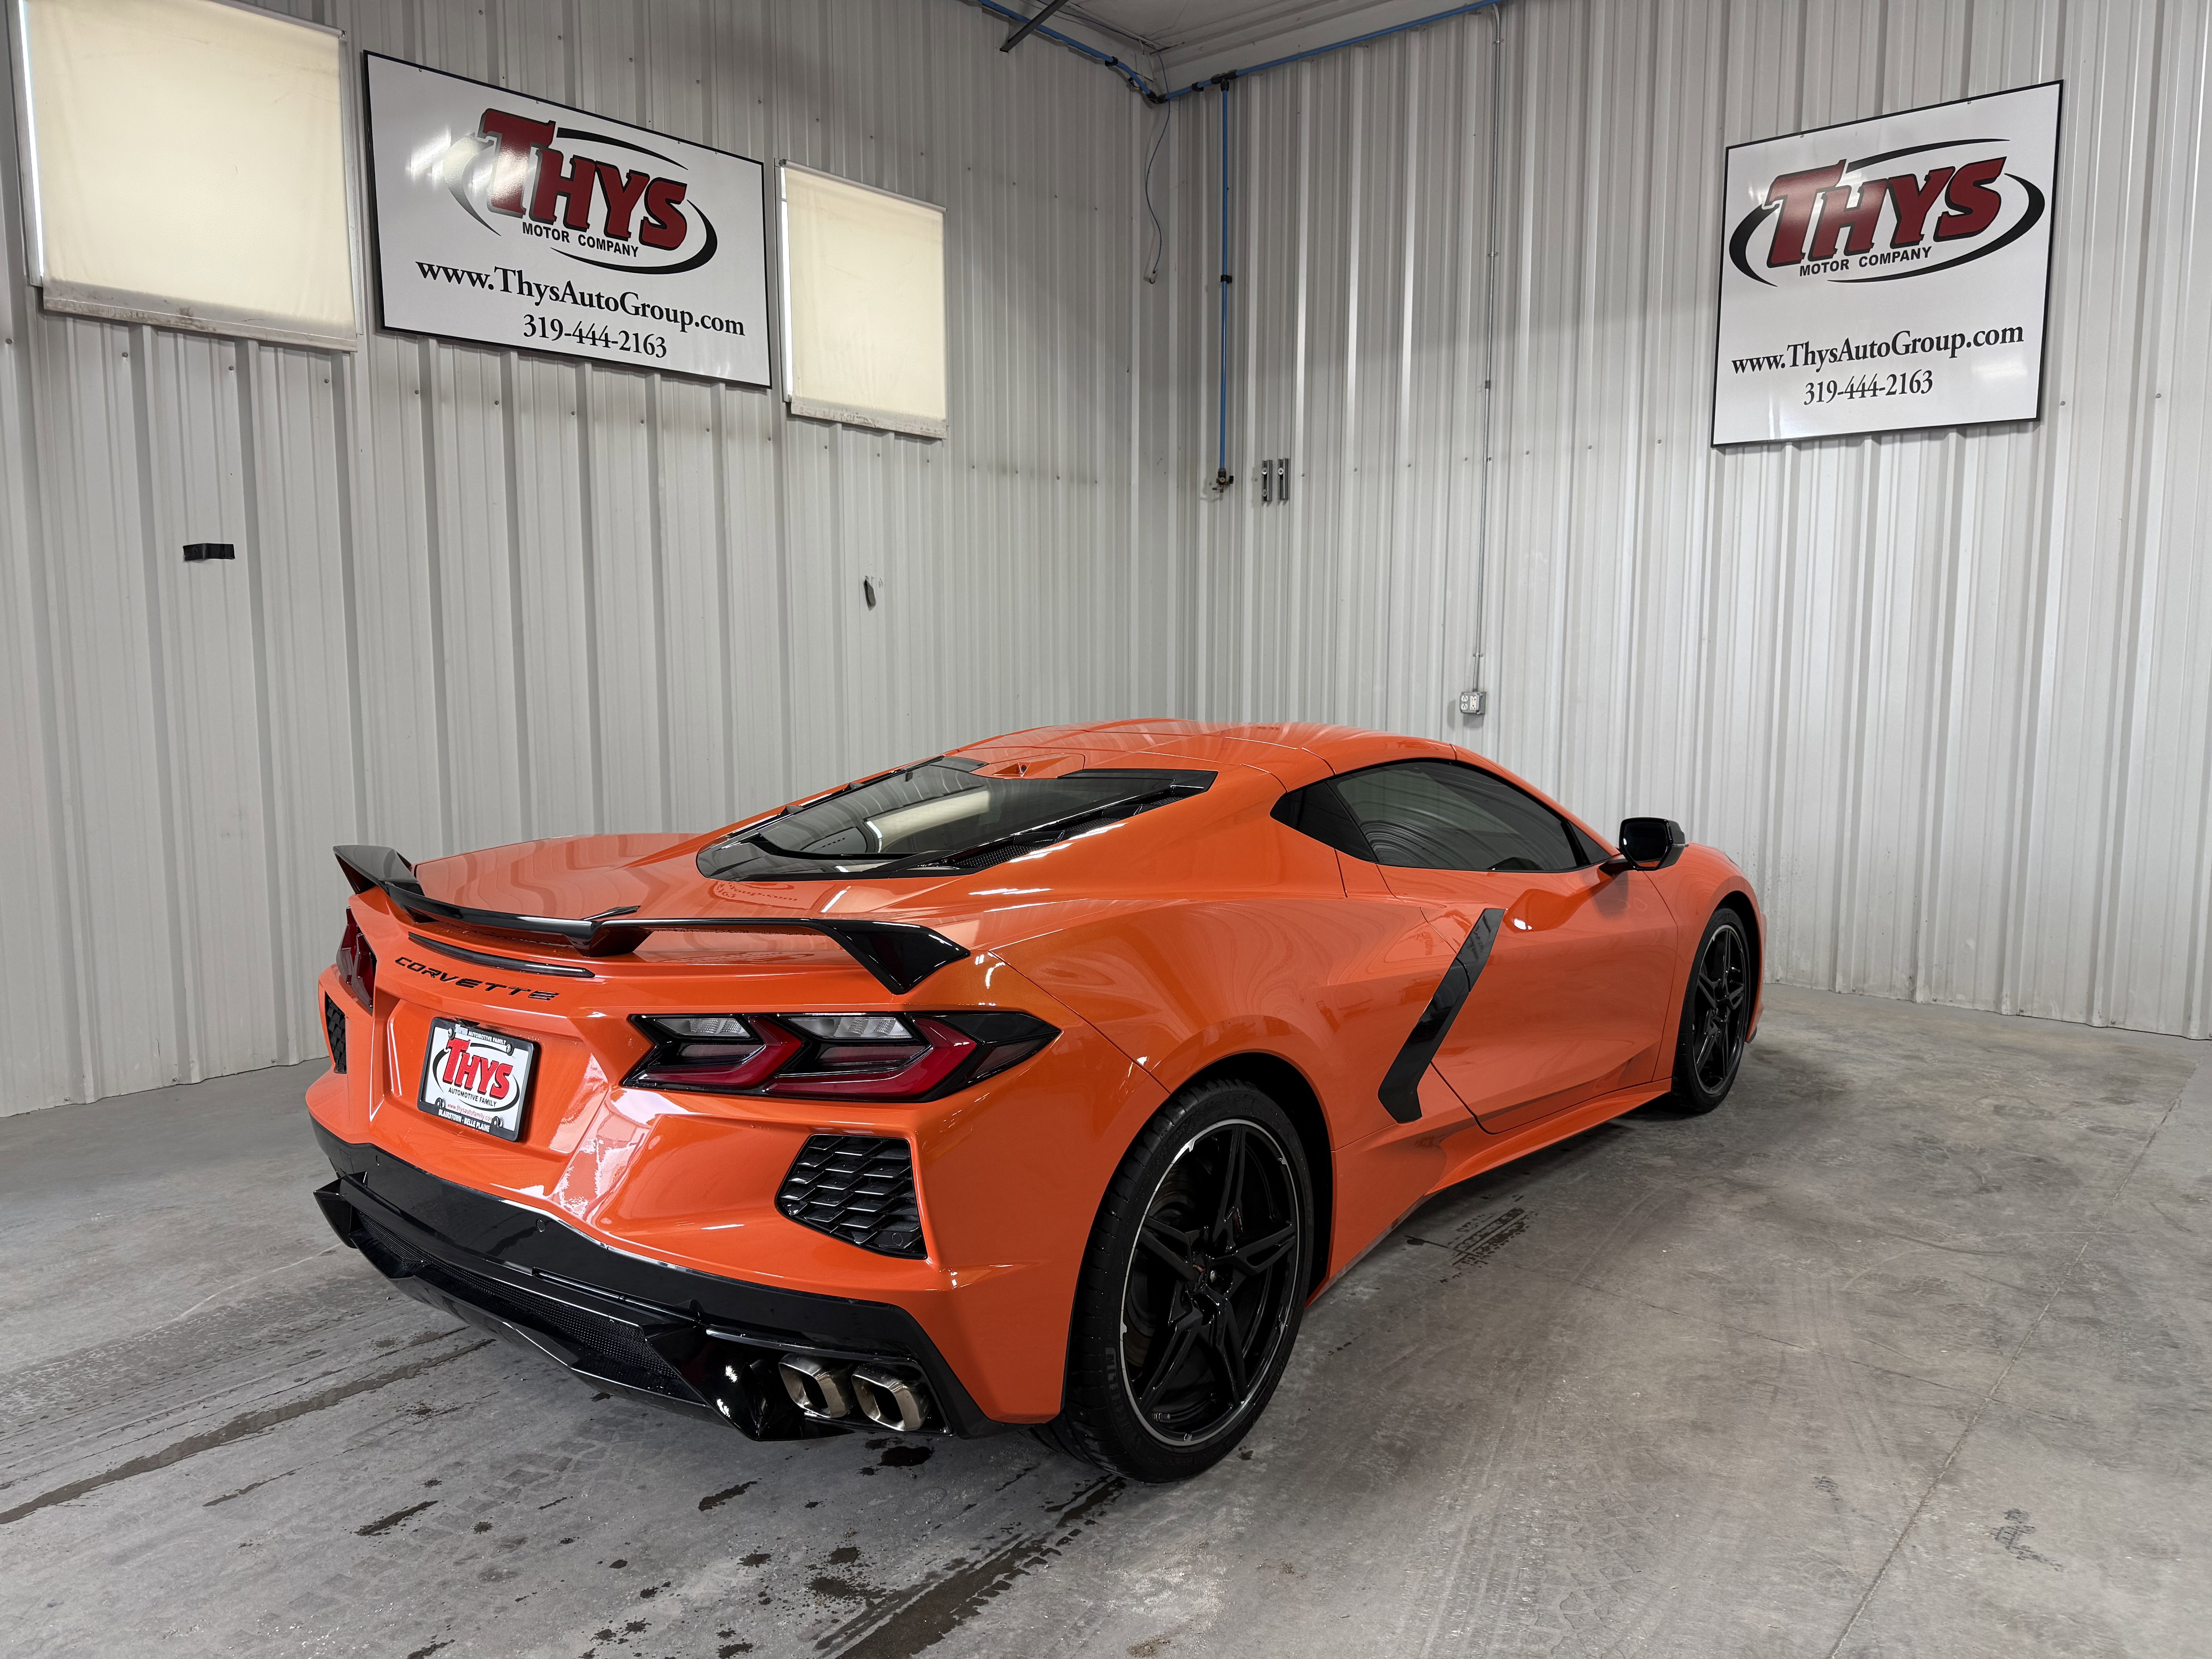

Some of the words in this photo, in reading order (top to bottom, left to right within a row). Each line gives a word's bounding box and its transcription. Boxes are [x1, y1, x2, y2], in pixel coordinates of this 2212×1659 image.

[477, 108, 689, 251] THYS
[1765, 156, 2007, 268] THYS
[523, 222, 570, 243] MOTOR
[579, 234, 639, 257] COMPANY
[1800, 259, 1849, 276] MOTOR
[1859, 246, 1932, 267] COMPANY
[416, 262, 745, 336] www.ThysAutoGroup.com
[524, 314, 667, 358] 319-444-2163
[1732, 326, 2024, 374] www.ThysAutoGroup.com
[1804, 369, 1933, 405] 319-444-2163
[395, 956, 560, 1001] CORVETTE
[468, 1030, 492, 1042] AUTOMOTIVE
[443, 1038, 514, 1099] THYS
[448, 1087, 479, 1101] AUTOMOTIVE
[479, 1097, 497, 1107] FAMILY
